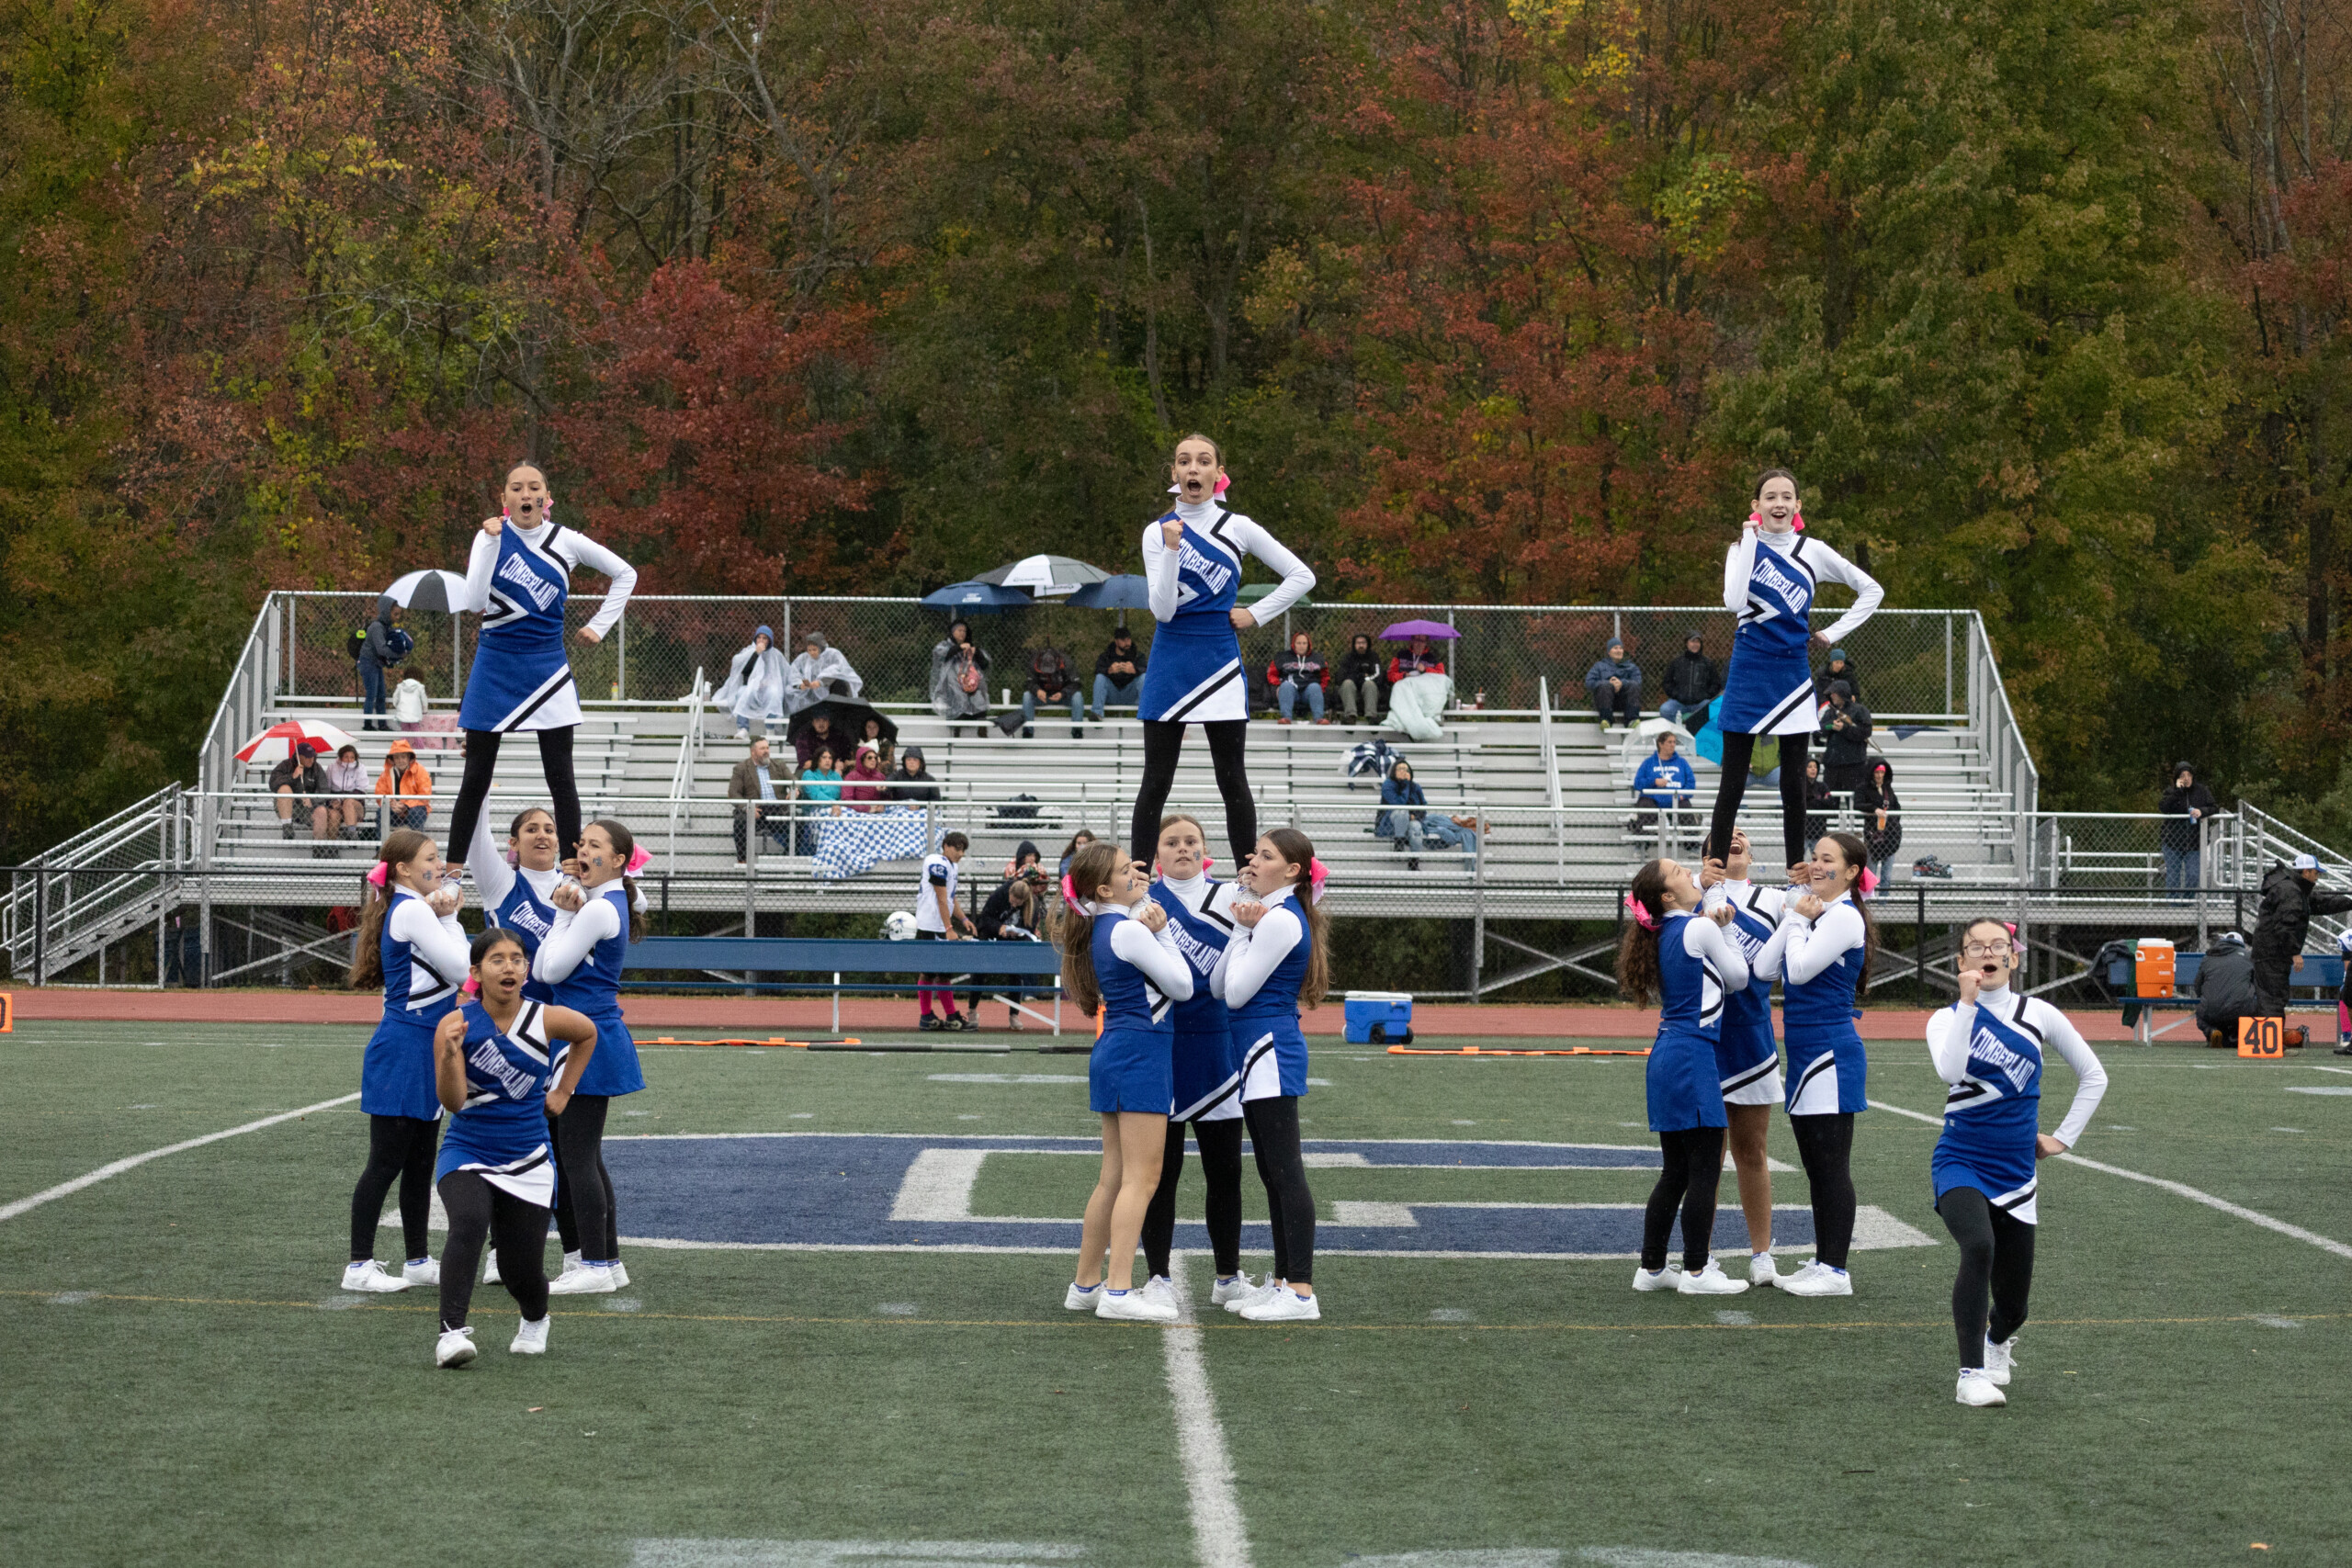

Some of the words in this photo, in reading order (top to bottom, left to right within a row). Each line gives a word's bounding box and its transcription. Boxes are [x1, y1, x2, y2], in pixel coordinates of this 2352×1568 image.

[499, 551, 560, 613] CUMBERLAND
[1750, 557, 1808, 615] CUMBERLAND
[508, 900, 552, 942] CUMBERL
[1969, 1026, 2036, 1094] CUMBERLAND
[2244, 1021, 2278, 1055] 40
[469, 1038, 537, 1100] CUMBERLAND
